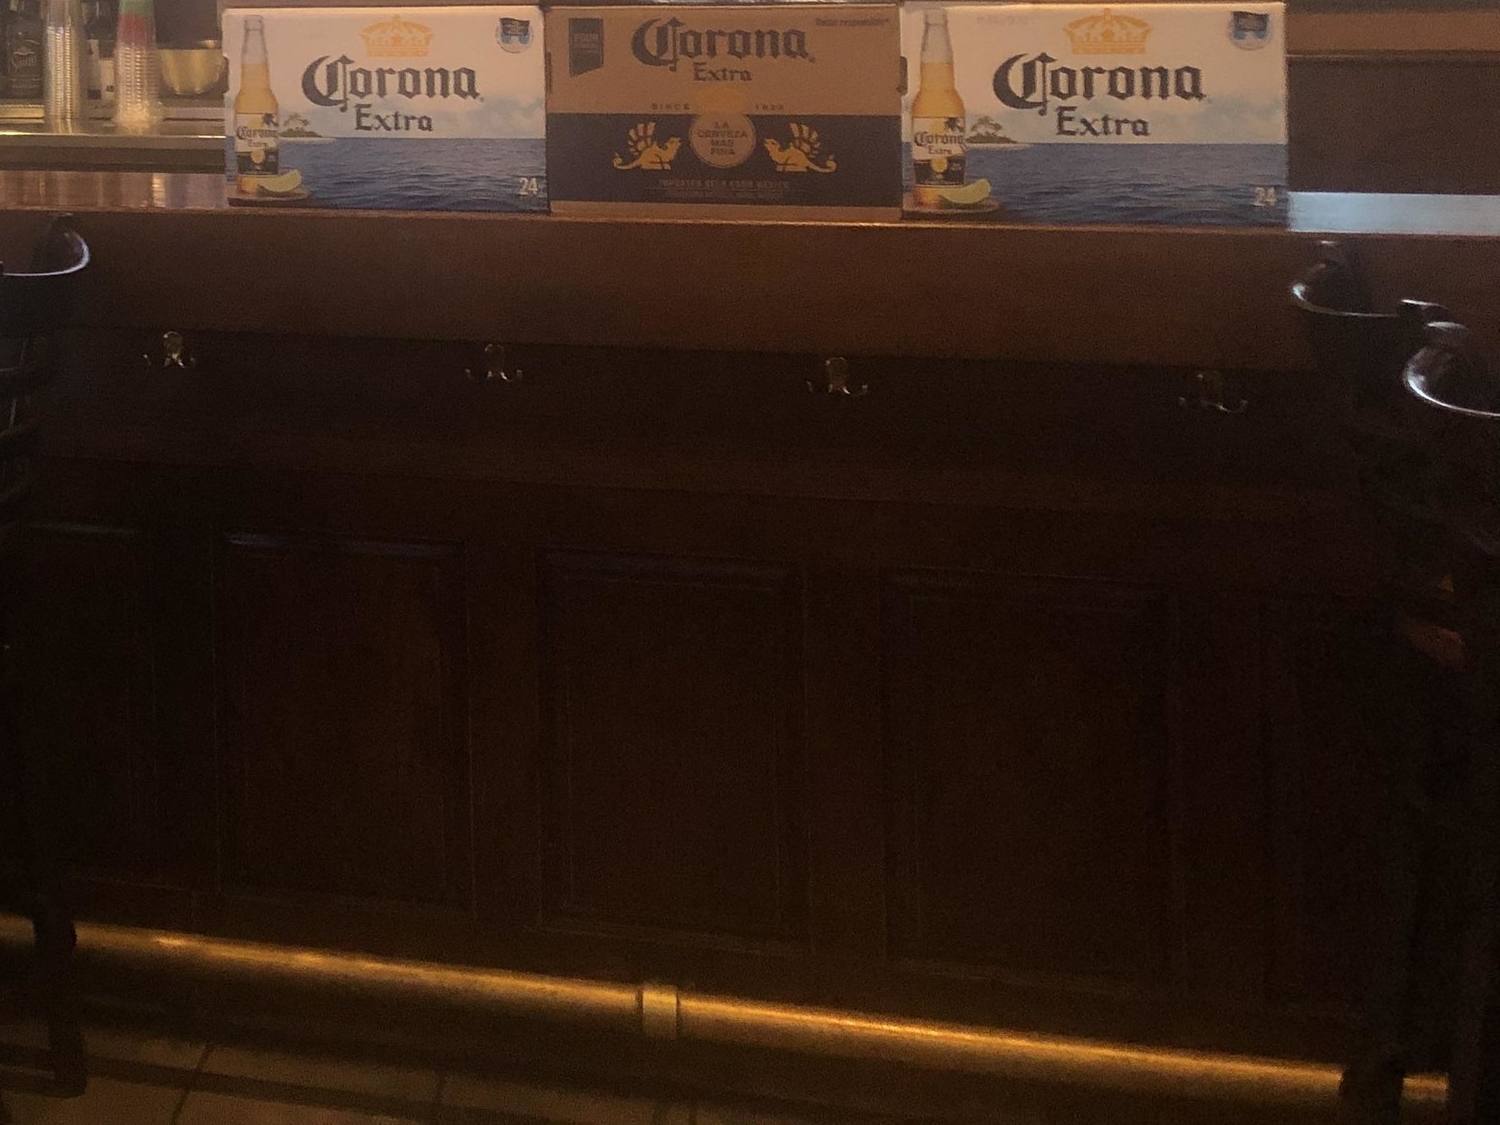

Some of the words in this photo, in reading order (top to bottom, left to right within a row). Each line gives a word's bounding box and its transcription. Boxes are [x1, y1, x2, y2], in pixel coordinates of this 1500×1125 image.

[631, 16, 809, 72] Corona
[693, 62, 752, 82] Extra
[301, 54, 480, 112] Corona
[992, 52, 1206, 116] Corona
[651, 103, 690, 111] SINCE
[354, 103, 433, 132] Extra
[714, 121, 730, 129] LA
[1055, 106, 1149, 136] Extra
[696, 129, 748, 139] CERVEZA
[914, 131, 965, 146] Corona
[710, 147, 735, 156] FINA
[927, 145, 952, 155] Extra
[518, 178, 539, 195] 24
[1254, 186, 1276, 206] 24
